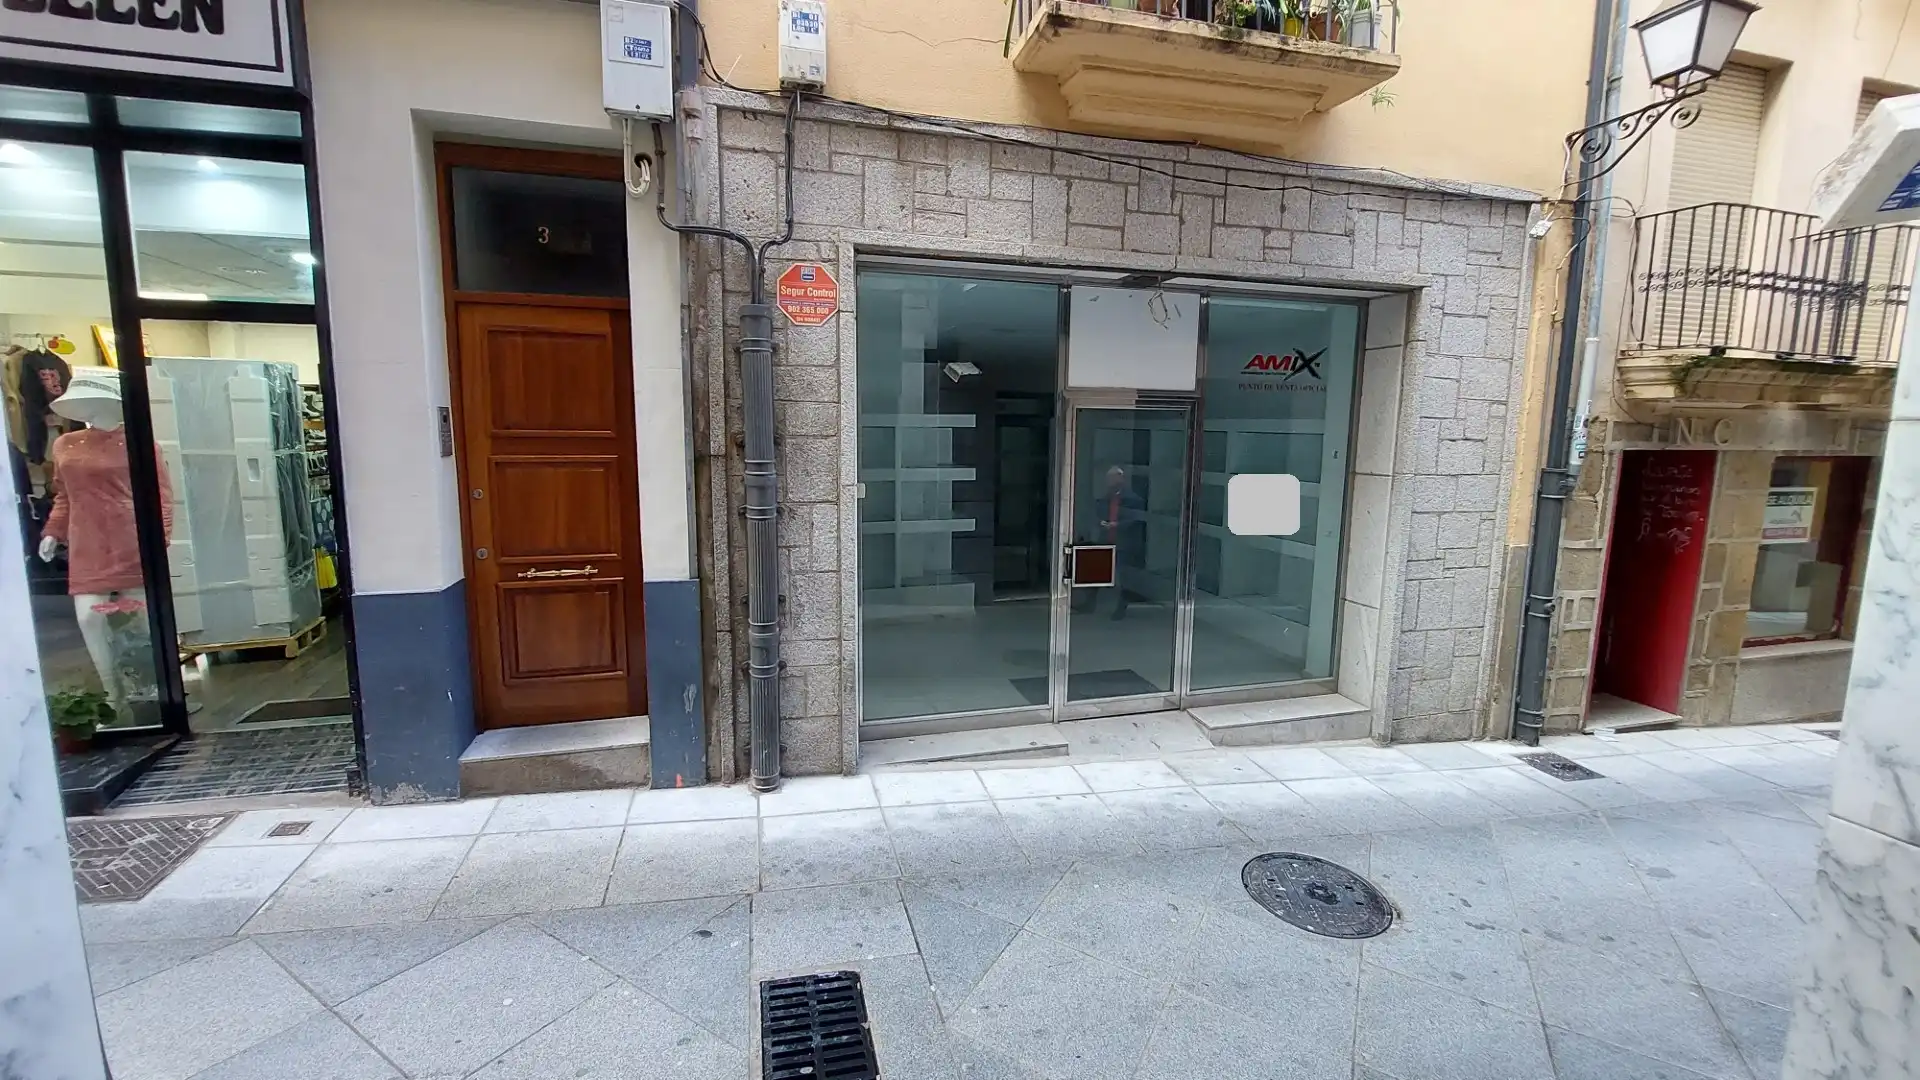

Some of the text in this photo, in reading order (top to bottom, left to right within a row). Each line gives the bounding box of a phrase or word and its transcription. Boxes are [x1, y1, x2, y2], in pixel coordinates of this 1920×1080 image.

[538, 226, 549, 243] 3
[781, 285, 836, 298] Segur Control
[787, 305, 800, 313] 902
[1244, 347, 1328, 380] AMIX
[1238, 383, 1262, 391] PUNTO
[1276, 384, 1298, 392] VENTA
